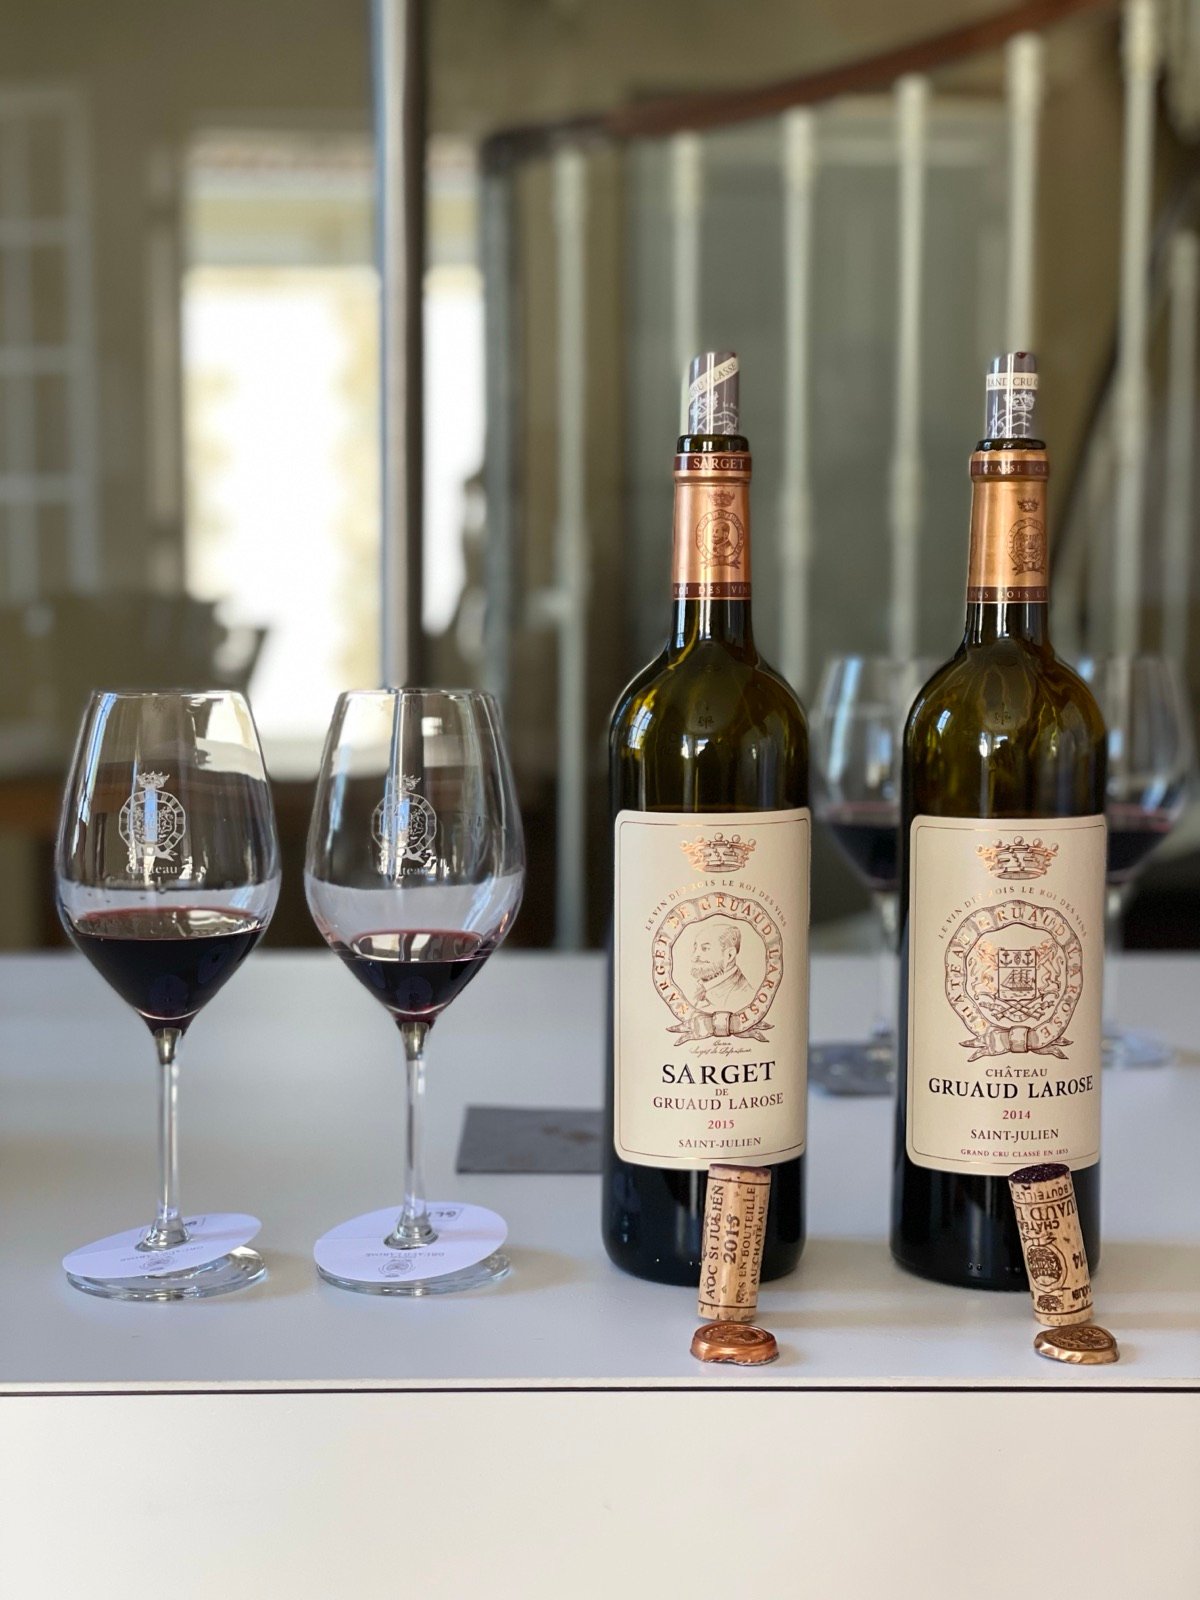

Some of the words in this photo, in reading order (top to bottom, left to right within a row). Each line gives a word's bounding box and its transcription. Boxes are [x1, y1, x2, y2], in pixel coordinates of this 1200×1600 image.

[693, 457, 745, 469] SARGET
[722, 878, 735, 887] LE
[739, 882, 757, 894] ROI
[1021, 886, 1035, 895] LE
[698, 895, 774, 937] GRUAUD
[738, 948, 780, 1024] LAROSE
[1040, 945, 1082, 1039] LAROSE
[662, 1061, 775, 1085] SARGET
[985, 1065, 1048, 1077] CHÂTEAU
[715, 1088, 729, 1097] DE
[928, 1077, 1018, 1098] GRUAUD
[1028, 1075, 1093, 1098] LAROSE
[653, 1096, 721, 1111] GRUAUD
[728, 1092, 784, 1110] LAROSE
[1002, 1110, 1031, 1120] 2014
[707, 1119, 735, 1130] 2015
[678, 1136, 761, 1149] SAINT-JULIEN
[970, 1128, 1059, 1143] SAINT-JULIEN
[960, 1148, 990, 1157] GRAND
[992, 1150, 1010, 1158] CRU
[1043, 1149, 1053, 1157] EN
[709, 1184, 725, 1242] JULIEN
[741, 1186, 757, 1258] BOUTEILLE
[708, 1243, 720, 1261] St
[739, 1260, 748, 1278] EN
[750, 1267, 759, 1286] AU
[706, 1264, 719, 1300] AOC
